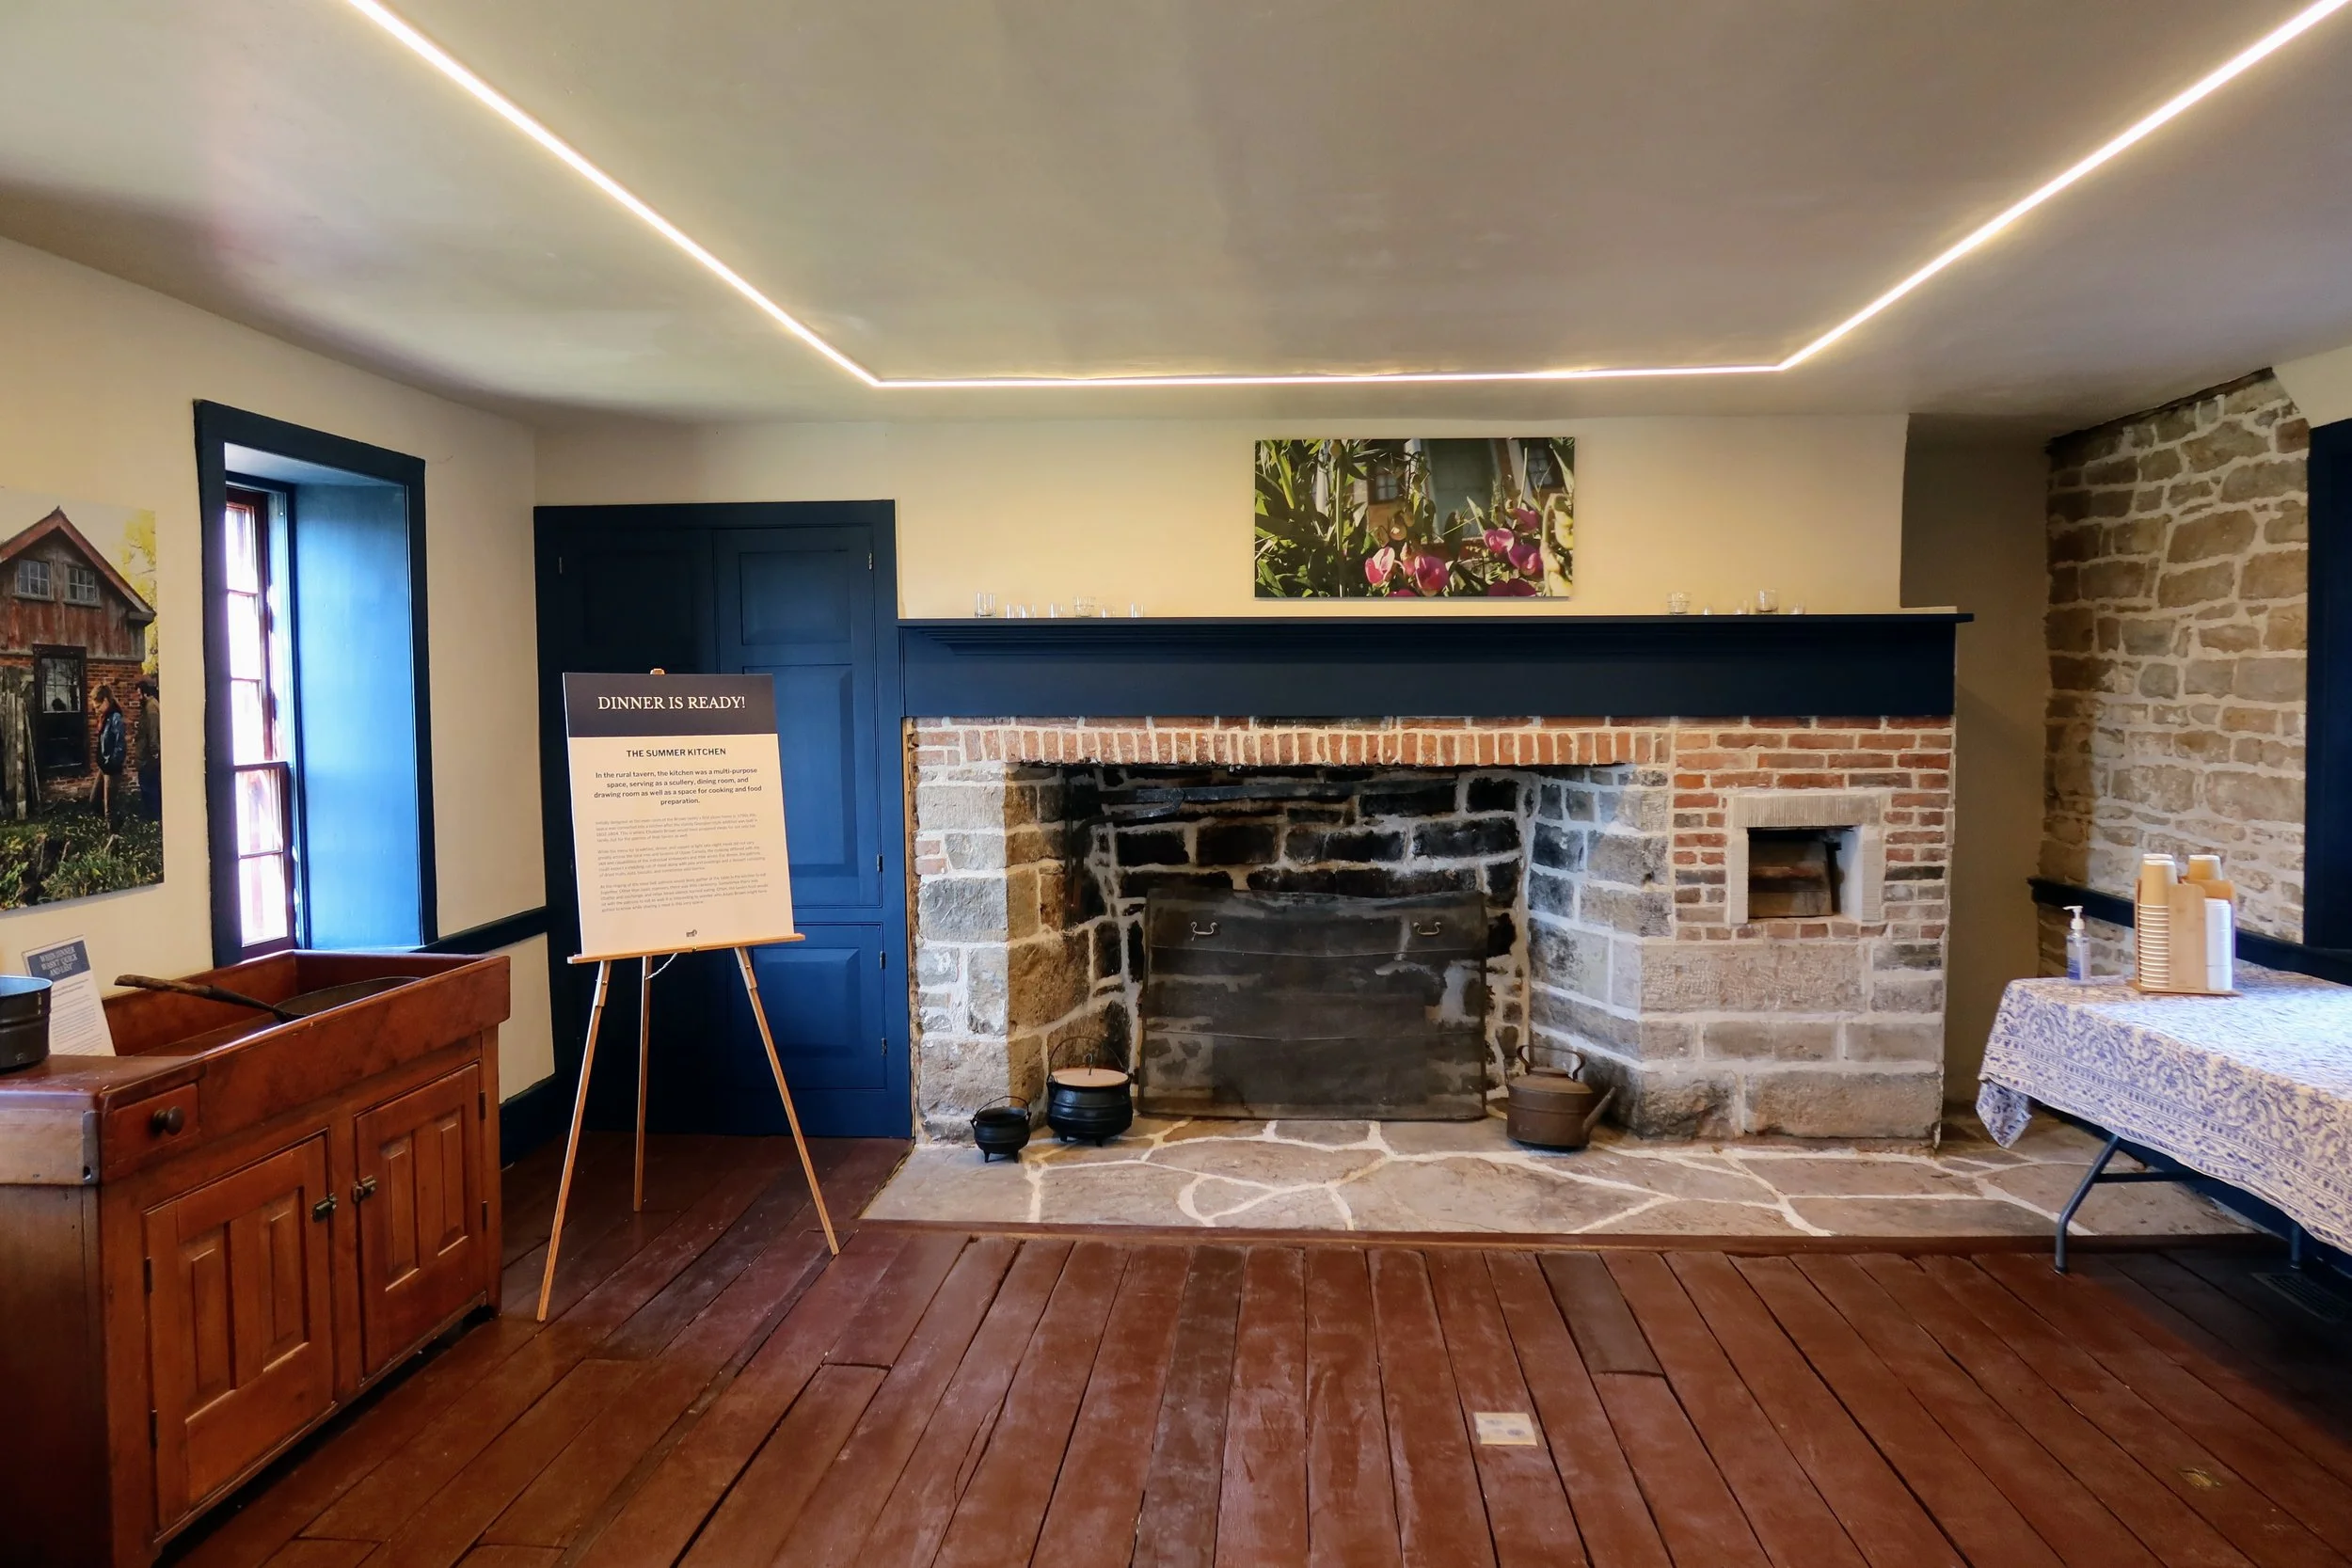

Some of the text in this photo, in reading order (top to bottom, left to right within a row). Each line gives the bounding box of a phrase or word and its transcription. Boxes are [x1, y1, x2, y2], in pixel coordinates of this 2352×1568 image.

[598, 696, 745, 709] DINNER IS READY!
